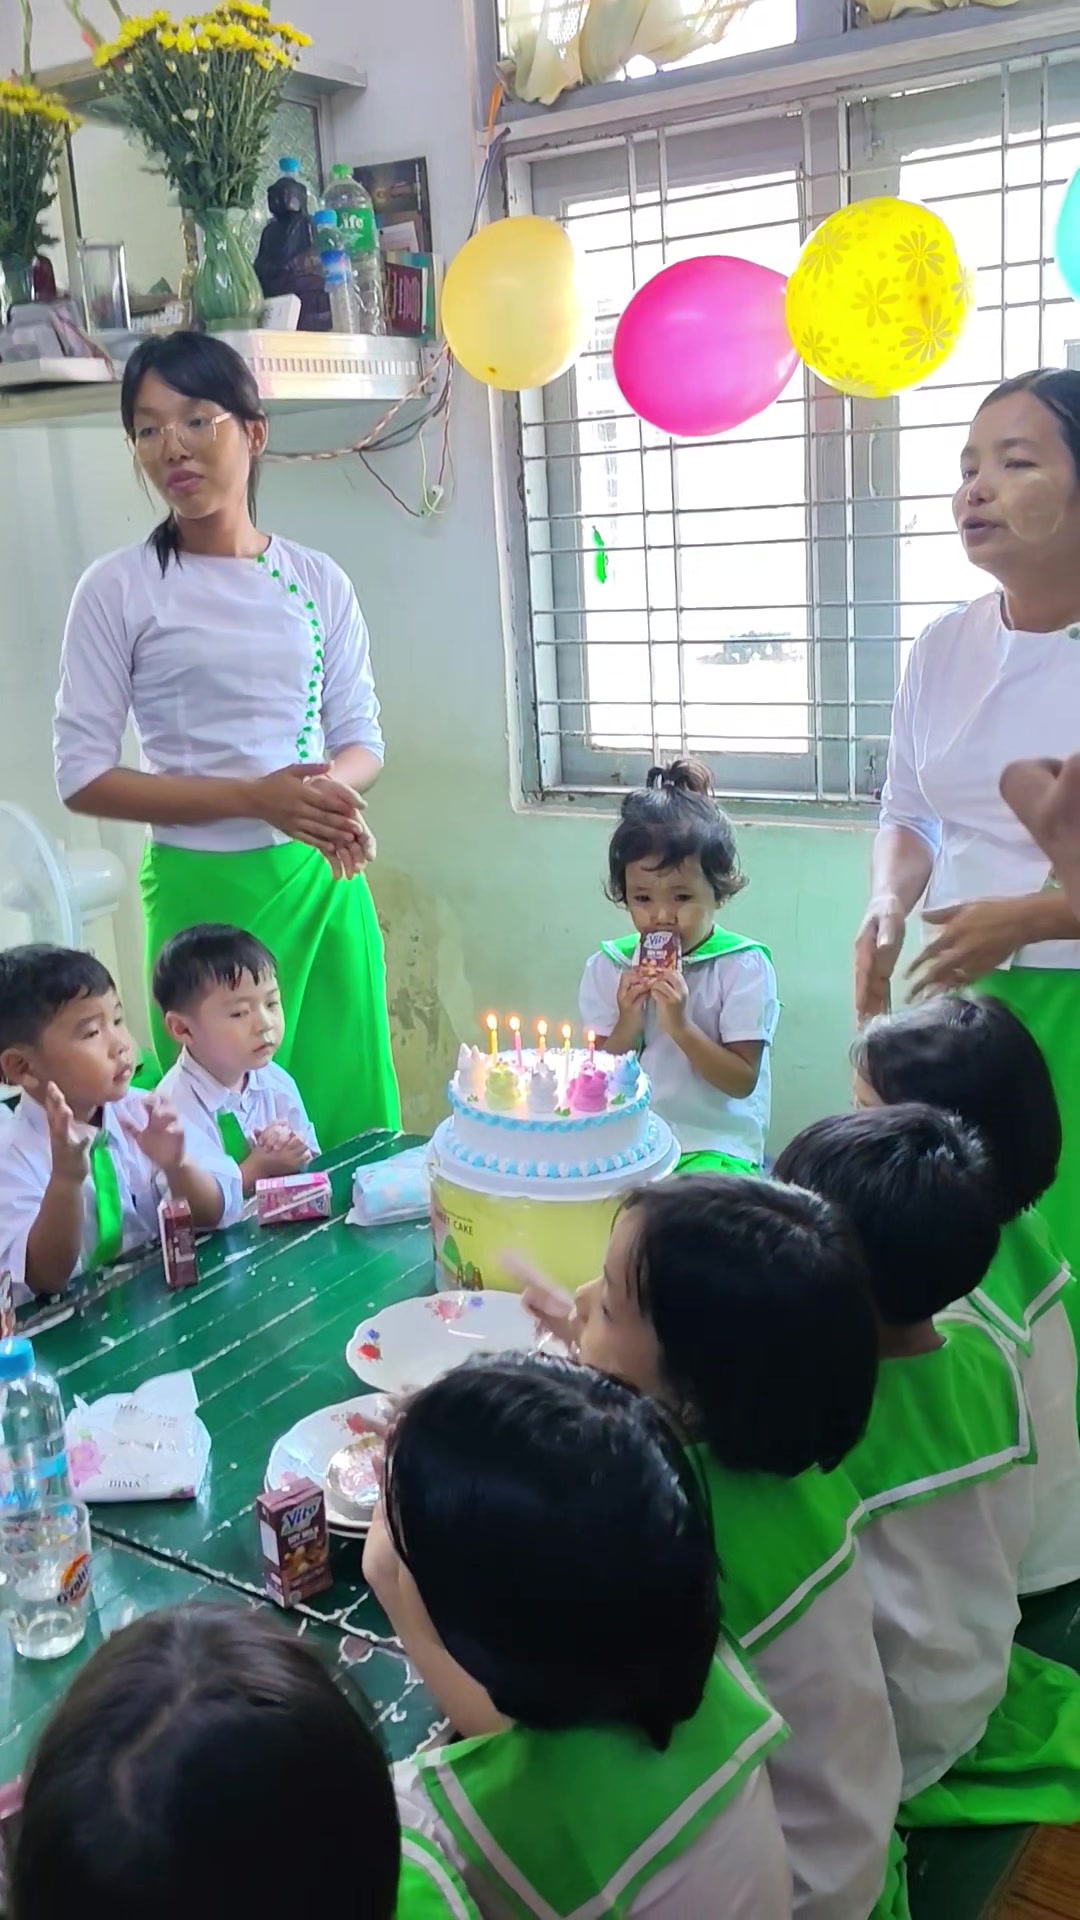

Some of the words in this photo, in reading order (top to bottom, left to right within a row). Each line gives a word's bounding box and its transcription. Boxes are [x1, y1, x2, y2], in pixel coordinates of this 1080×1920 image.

[453, 1220, 474, 1237] CAKE
[109, 1479, 141, 1489] DIMA
[286, 1504, 317, 1528] Vito
